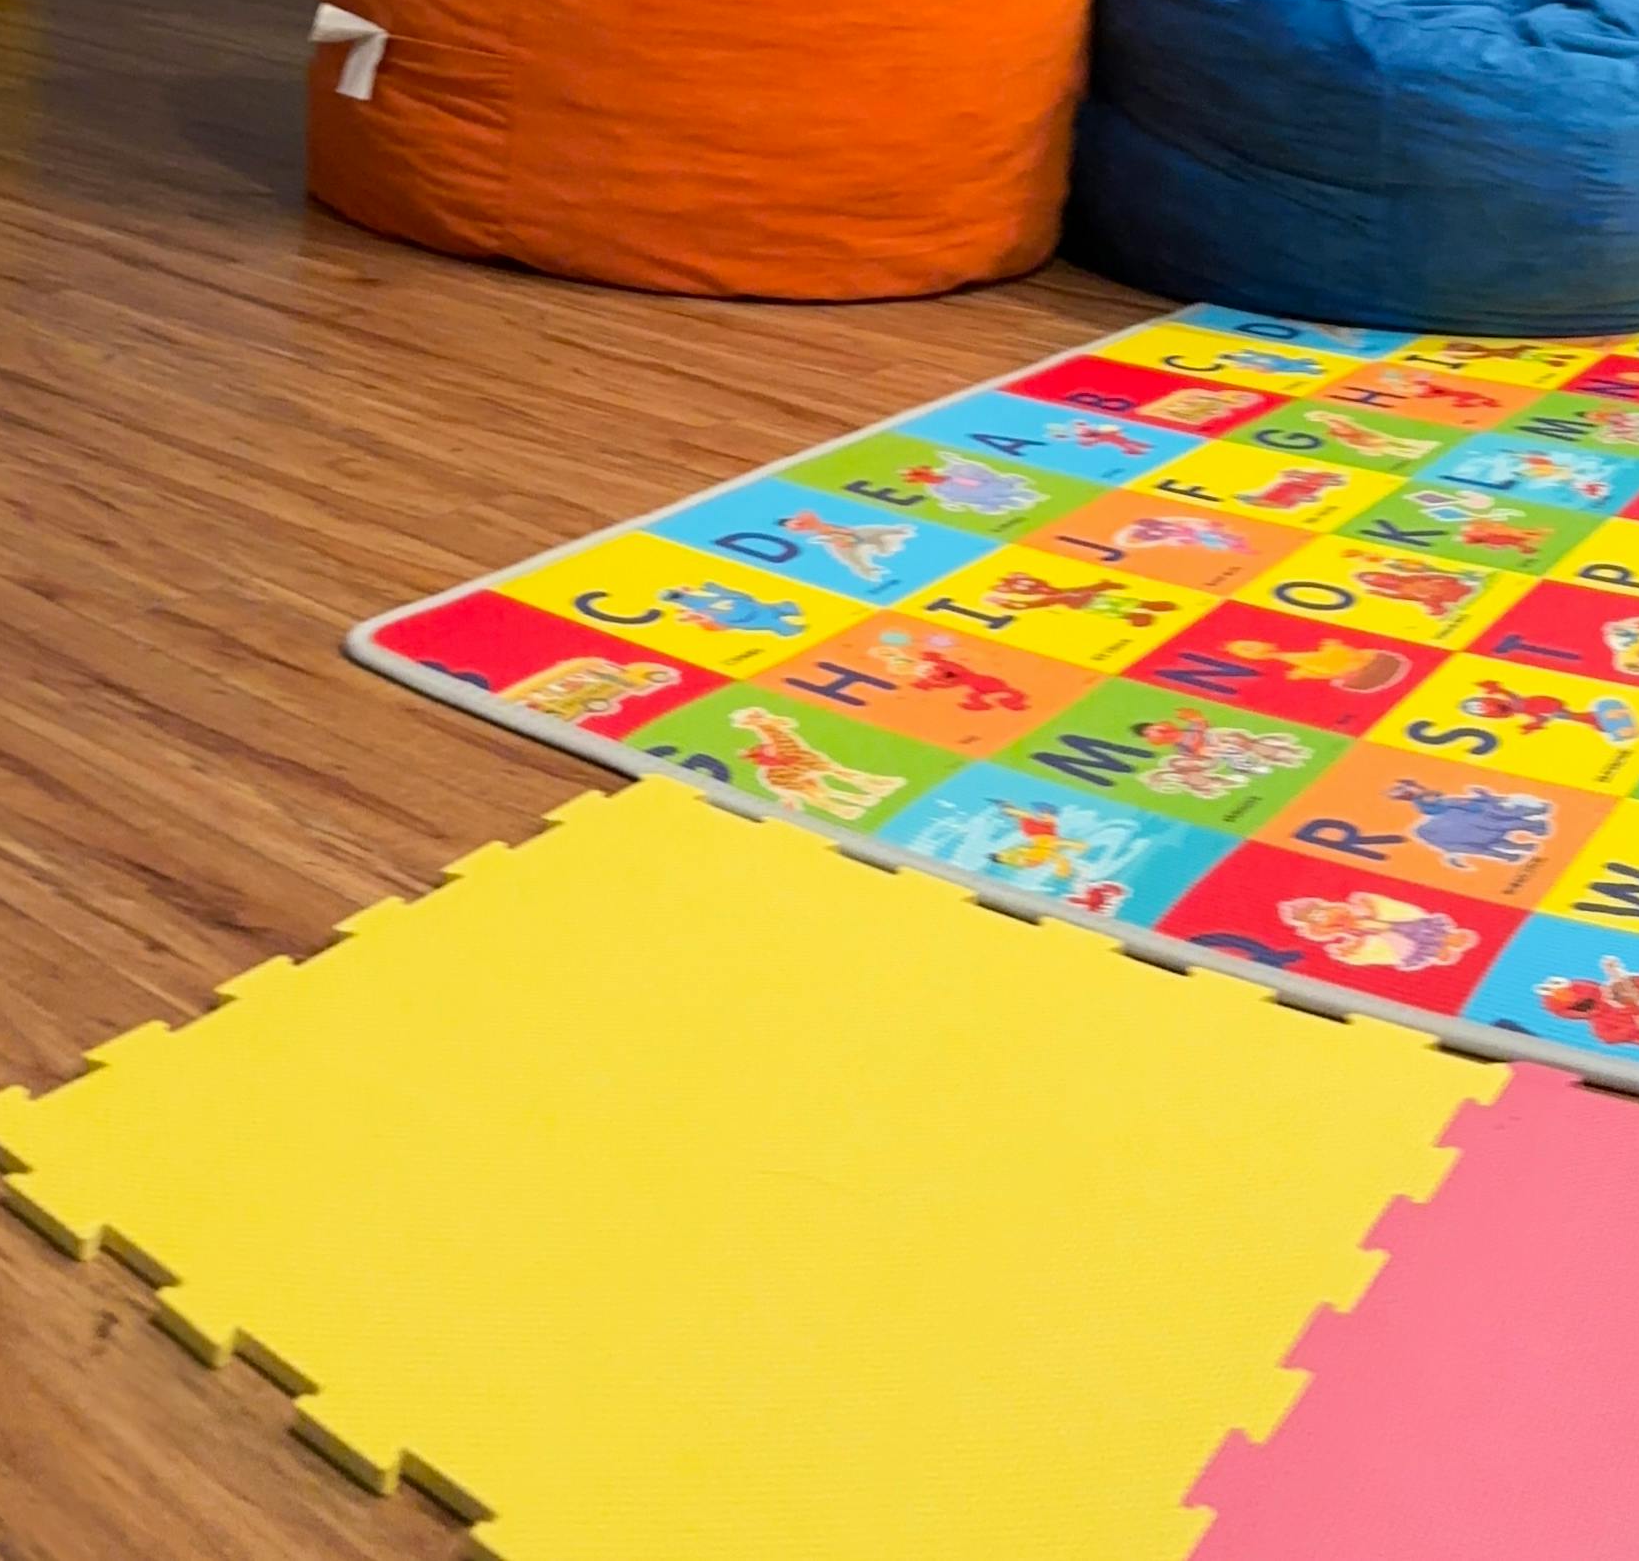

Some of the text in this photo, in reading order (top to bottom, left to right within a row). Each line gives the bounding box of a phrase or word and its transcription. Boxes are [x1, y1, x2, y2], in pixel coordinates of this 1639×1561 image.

[1164, 354, 1225, 374] C
[1065, 392, 1136, 413] B
[1328, 386, 1408, 409] H
[968, 431, 1048, 457] A
[1253, 428, 1328, 453] G
[1518, 416, 1594, 442] M
[843, 479, 926, 508] E
[1155, 478, 1227, 503] F
[715, 531, 802, 565] D
[1056, 533, 1125, 564] J
[1361, 518, 1450, 549] K
[574, 590, 664, 626] C
[1273, 580, 1356, 612] O
[925, 596, 1016, 631] I
[1491, 633, 1583, 662] T
[785, 660, 898, 707] H
[1155, 651, 1263, 696] N
[1405, 719, 1500, 757] S
[1031, 733, 1156, 788] M
[1292, 817, 1410, 863] R
